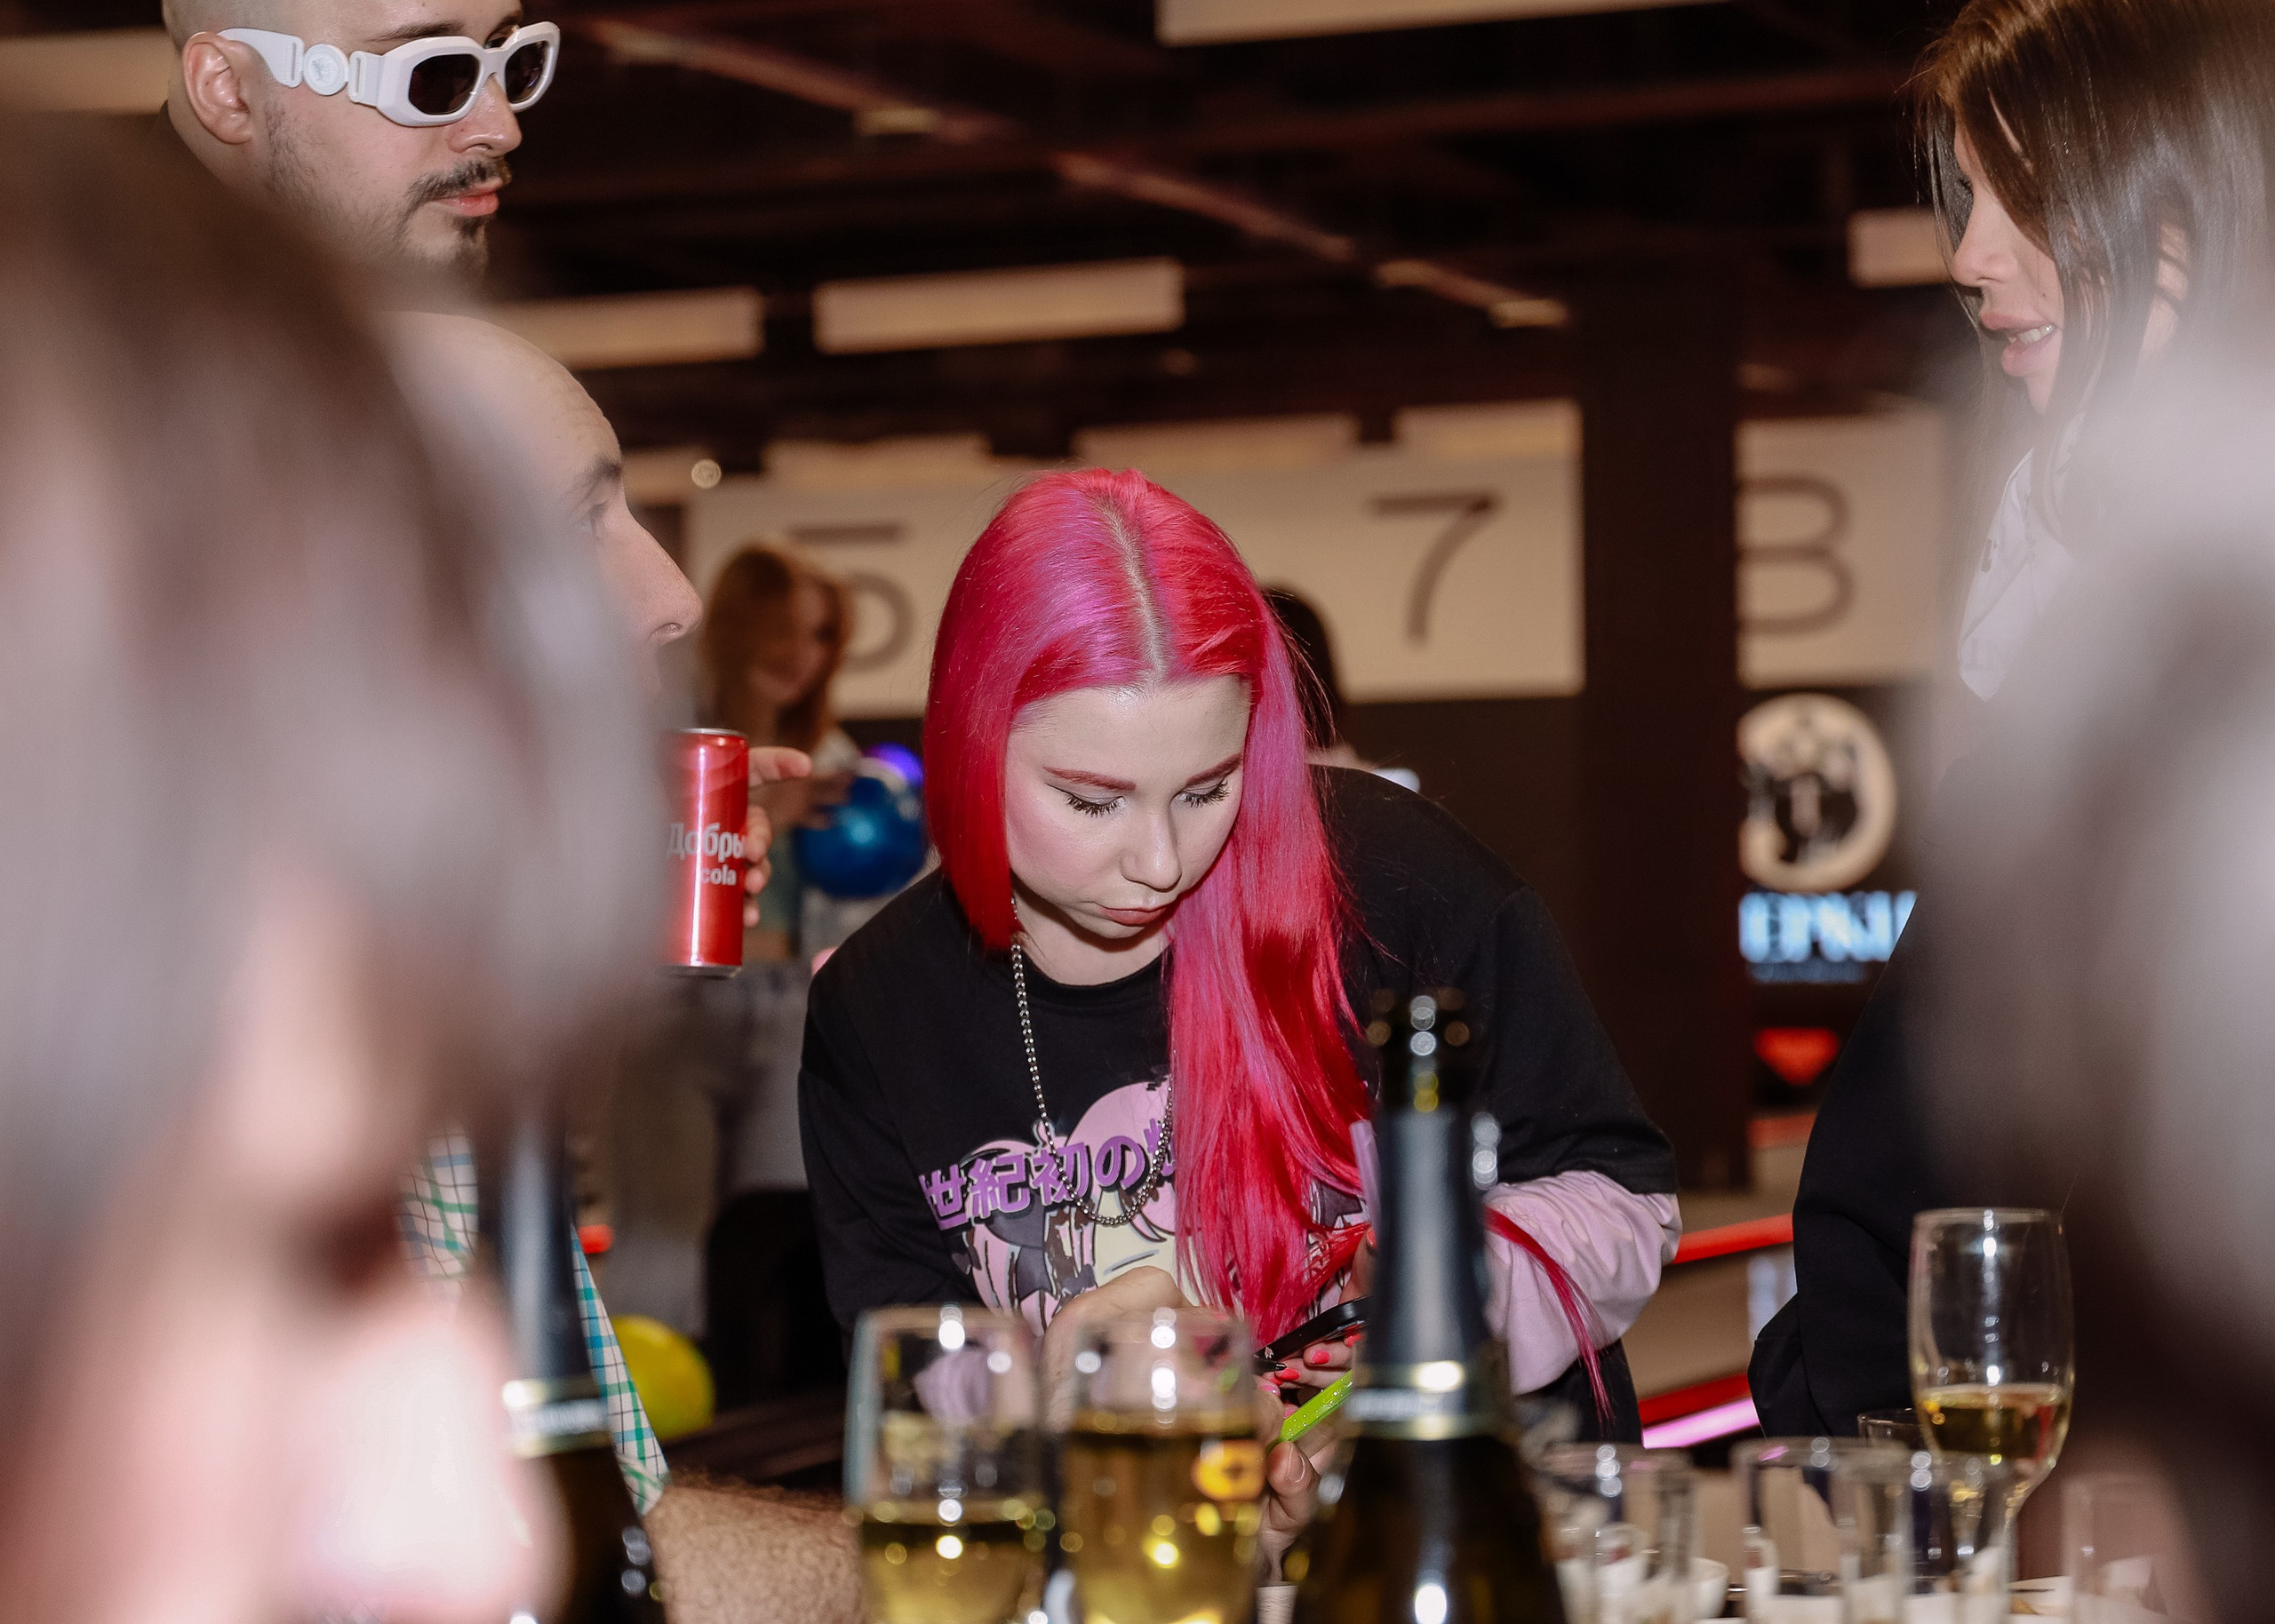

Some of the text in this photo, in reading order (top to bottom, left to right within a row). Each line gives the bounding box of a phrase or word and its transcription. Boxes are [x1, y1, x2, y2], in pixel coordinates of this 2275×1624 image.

[1367, 490, 1499, 647] 7
[665, 822, 744, 864] Добры
[699, 864, 738, 887] cola
[919, 1118, 1177, 1230] 世紀初の
